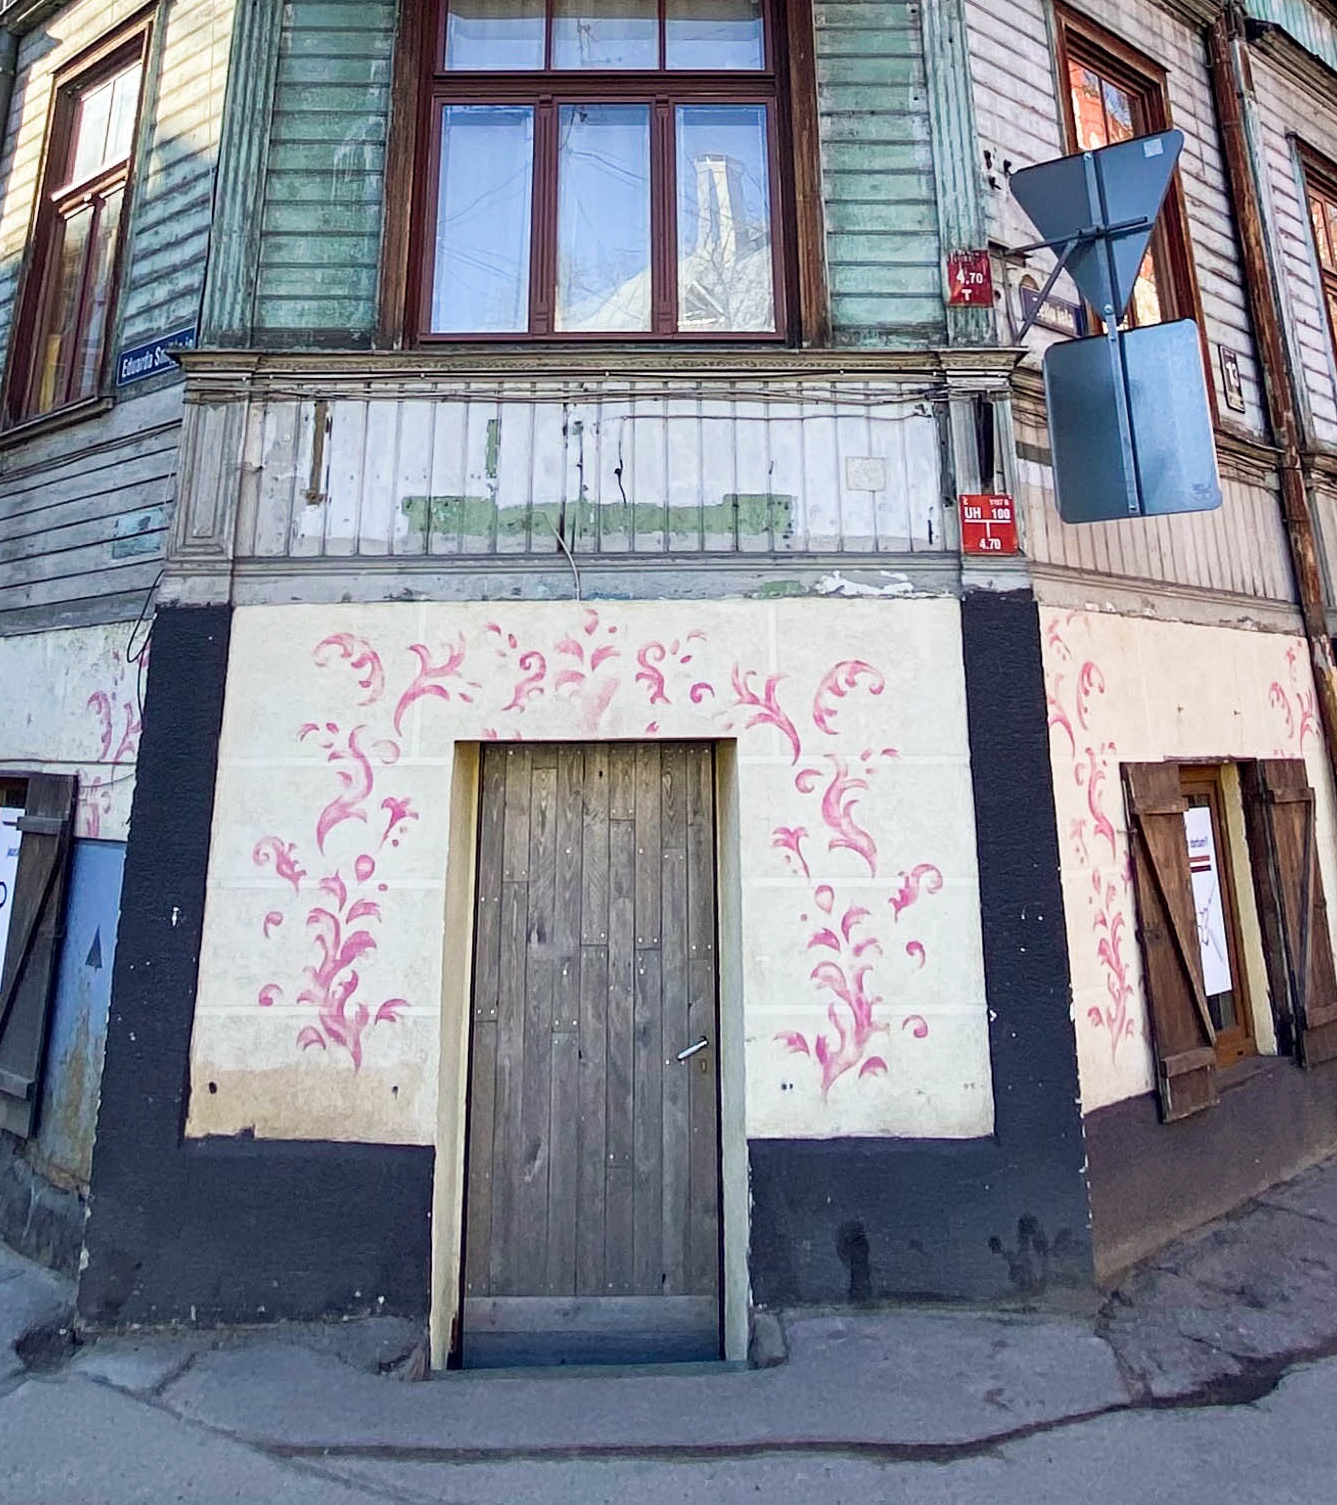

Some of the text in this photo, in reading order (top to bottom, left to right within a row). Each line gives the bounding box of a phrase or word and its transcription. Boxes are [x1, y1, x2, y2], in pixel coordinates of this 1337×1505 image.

[964, 506, 1011, 520] UH 100
[978, 538, 1002, 550] 4.70
